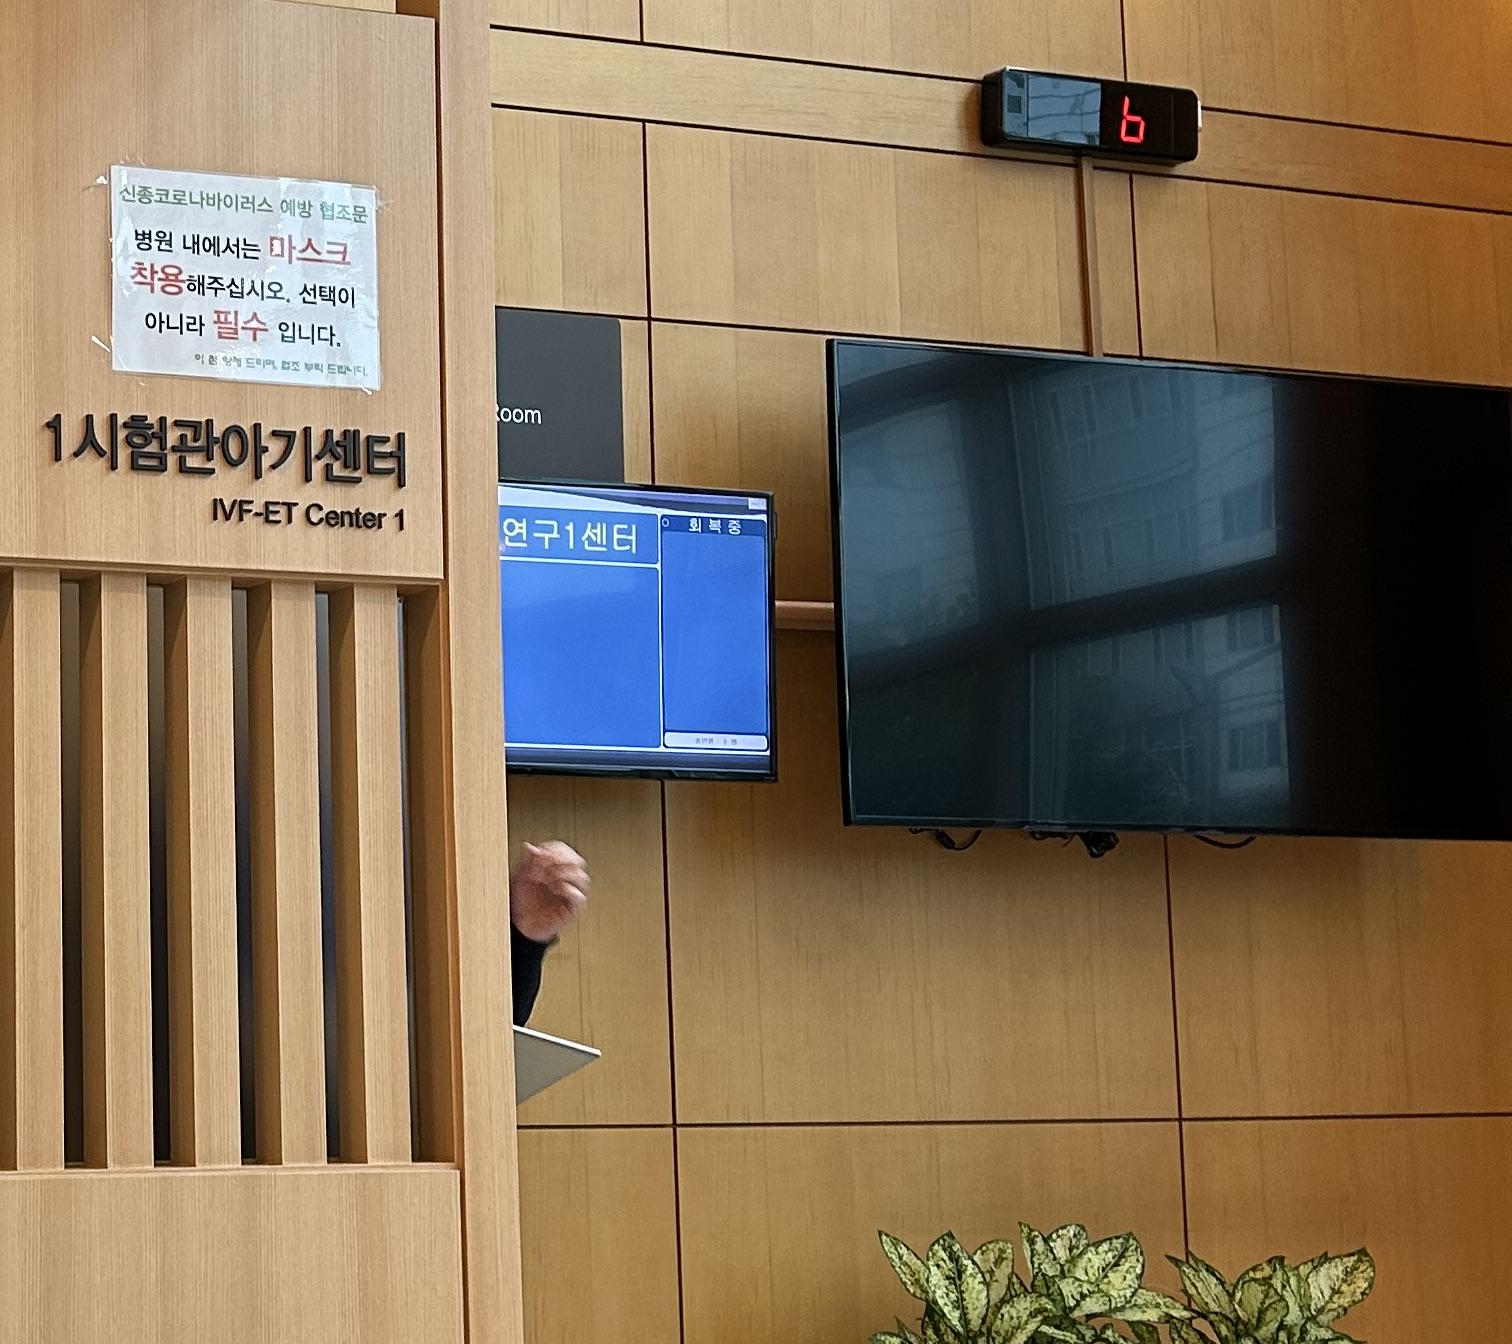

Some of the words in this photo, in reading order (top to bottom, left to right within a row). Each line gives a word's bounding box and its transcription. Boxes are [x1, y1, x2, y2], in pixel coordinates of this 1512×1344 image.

[119, 184, 274, 215] 신종코로나바이러스
[280, 199, 313, 219] 예방
[320, 201, 368, 224] 협조문
[133, 229, 174, 253] 병원
[182, 233, 261, 261] 내에서는
[268, 233, 351, 265] 마스크
[129, 262, 292, 305] 착용해주십시오.
[298, 283, 356, 309] 선택이
[144, 311, 205, 337] 아니라
[212, 309, 269, 341] 필수
[278, 322, 342, 347] 입니다.
[45, 412, 407, 489] 1시험관아기센터
[212, 498, 298, 525] IVF-ET
[305, 503, 388, 529] Center
[394, 509, 405, 531] 1
